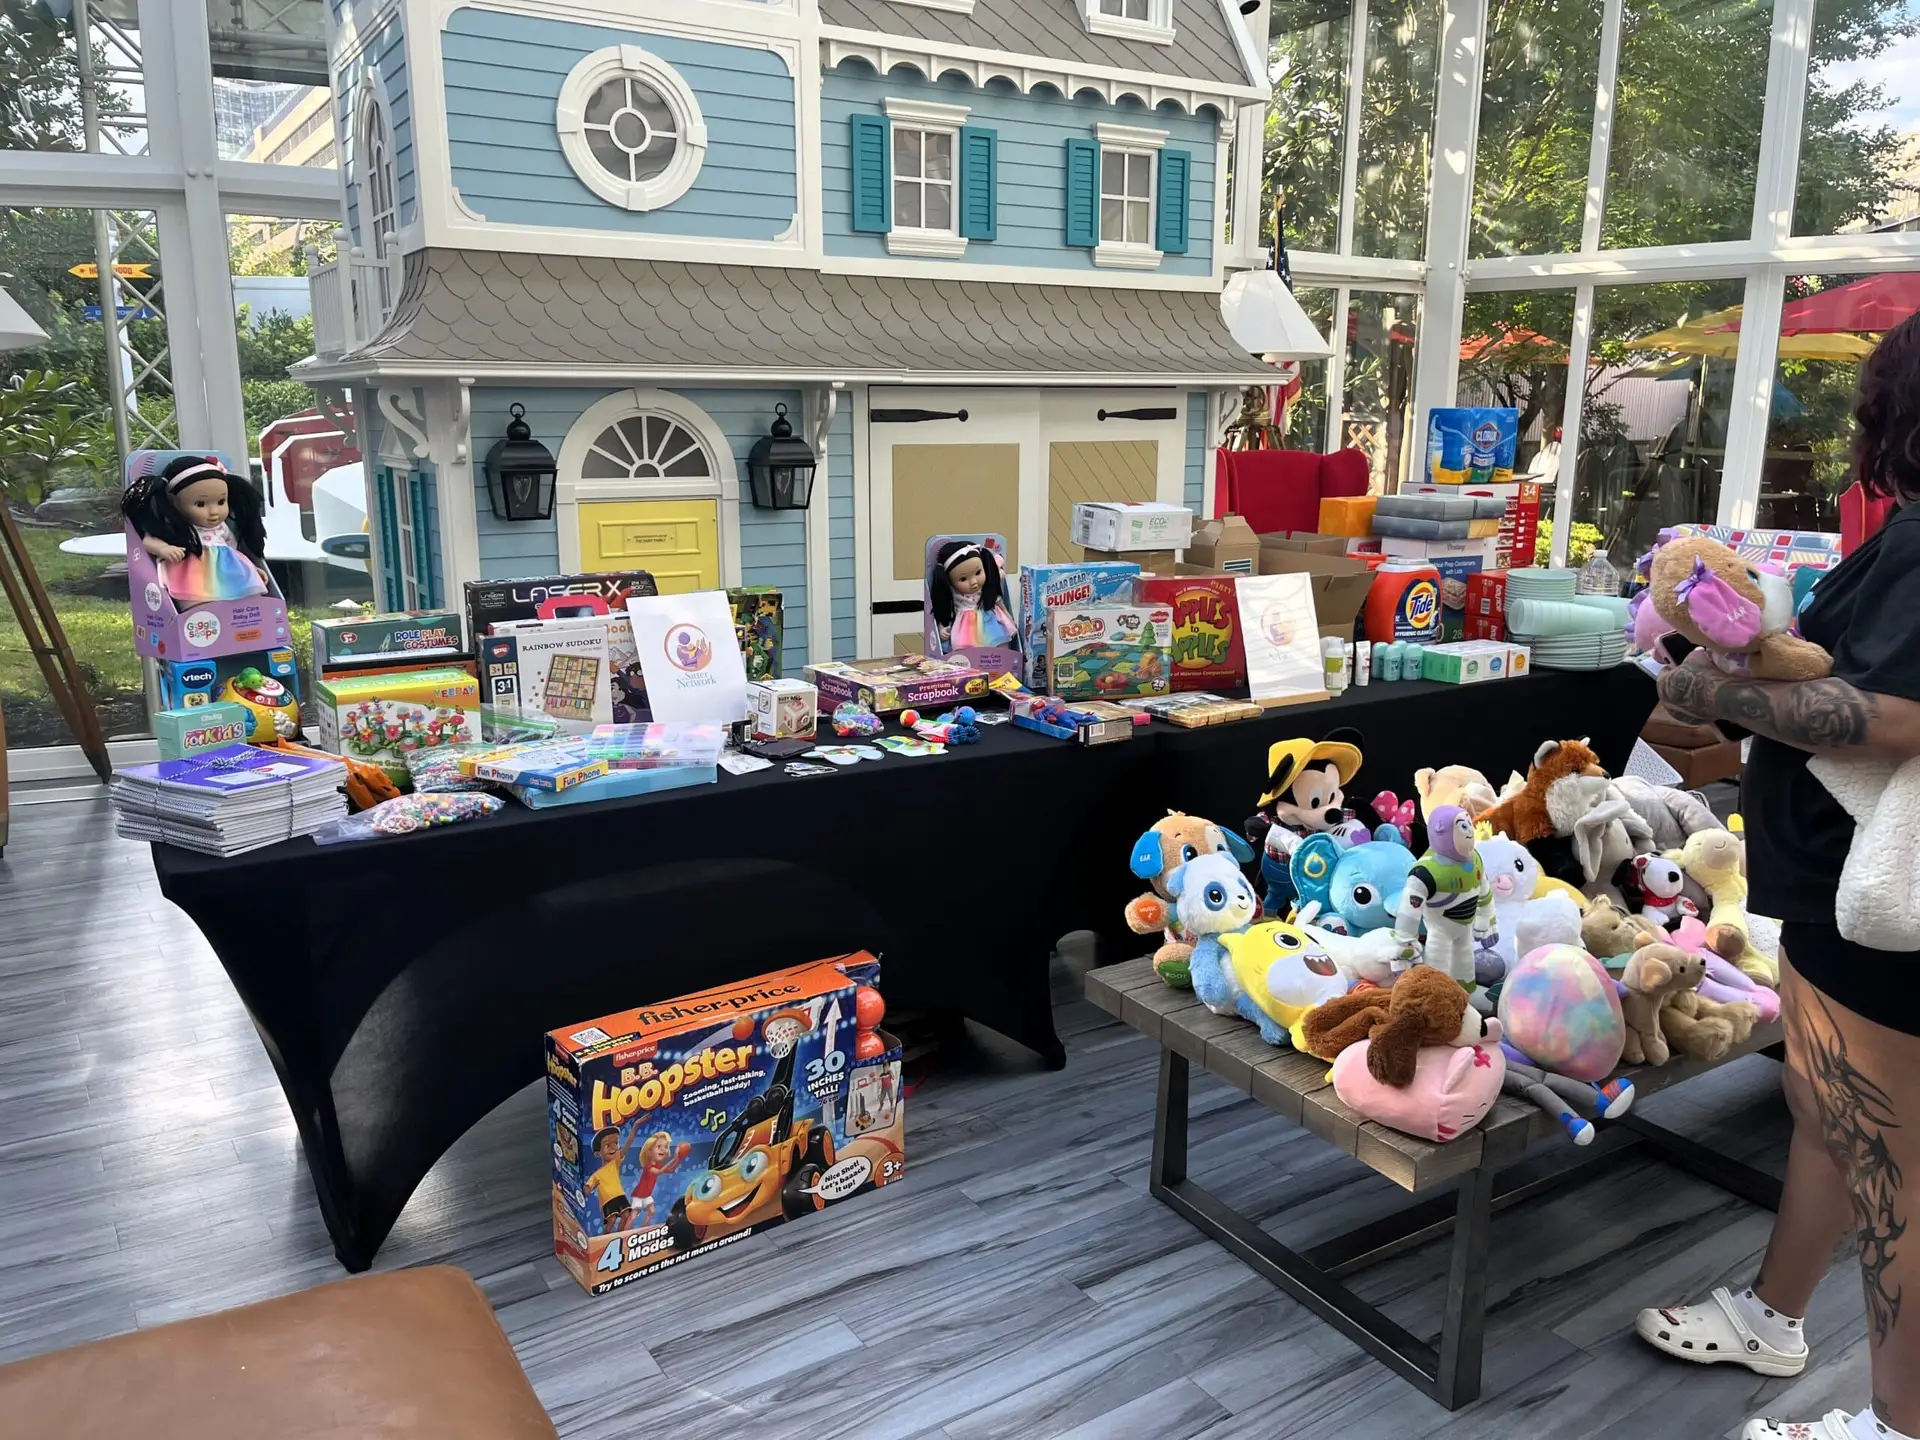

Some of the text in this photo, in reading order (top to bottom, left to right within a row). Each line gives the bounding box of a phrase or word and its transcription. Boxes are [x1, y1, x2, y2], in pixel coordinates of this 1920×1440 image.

[89, 267, 132, 275] HOWOOD
[1523, 485, 1537, 496] 34
[606, 580, 622, 596] X
[1046, 577, 1069, 594] POLAR
[1069, 573, 1087, 588] BEAR
[1047, 585, 1090, 607] PLUNGE!
[232, 606, 244, 614] Hair
[1410, 594, 1434, 620] Tide
[233, 613, 248, 621] Baby
[186, 620, 218, 633] Giggle
[1060, 619, 1104, 637] ROAD
[395, 628, 446, 642] ROLE PLAY
[404, 636, 458, 650] COSTUMES
[522, 642, 564, 652] RAINBOW
[566, 639, 602, 648] SUDOKU
[182, 672, 212, 682] vtech
[491, 666, 501, 675] 3+
[684, 672, 709, 680] Sitter
[676, 675, 717, 688] Network
[820, 681, 853, 698] Scrapbook
[919, 682, 950, 692] Premium
[1153, 680, 1164, 688] 28
[908, 685, 959, 702] Scrapbook
[477, 766, 514, 781] Fun Phone
[562, 776, 576, 787] Fun
[578, 768, 601, 782] Phone
[1140, 854, 1151, 862] EAR
[637, 984, 801, 1026] fisher-price
[616, 1045, 656, 1061] fisher-price
[621, 1062, 659, 1086] B.B.
[804, 1050, 846, 1082] 30
[592, 1044, 754, 1131] Hoopster
[682, 1070, 766, 1101] Zooming, fast-talking,
[807, 1072, 845, 1092] INCHES
[684, 1080, 751, 1108] basketball buddy!
[814, 1084, 838, 1100] TALL!
[824, 1160, 860, 1183] Nice Shot!
[883, 1160, 902, 1178] 3+
[820, 1179, 839, 1192] Let's
[840, 1166, 866, 1184] baaack
[842, 1179, 856, 1192] up!
[597, 1225, 669, 1271] 4 Game
[628, 1236, 675, 1262] Modes
[598, 1228, 752, 1293] Try to score as the net moves around!
